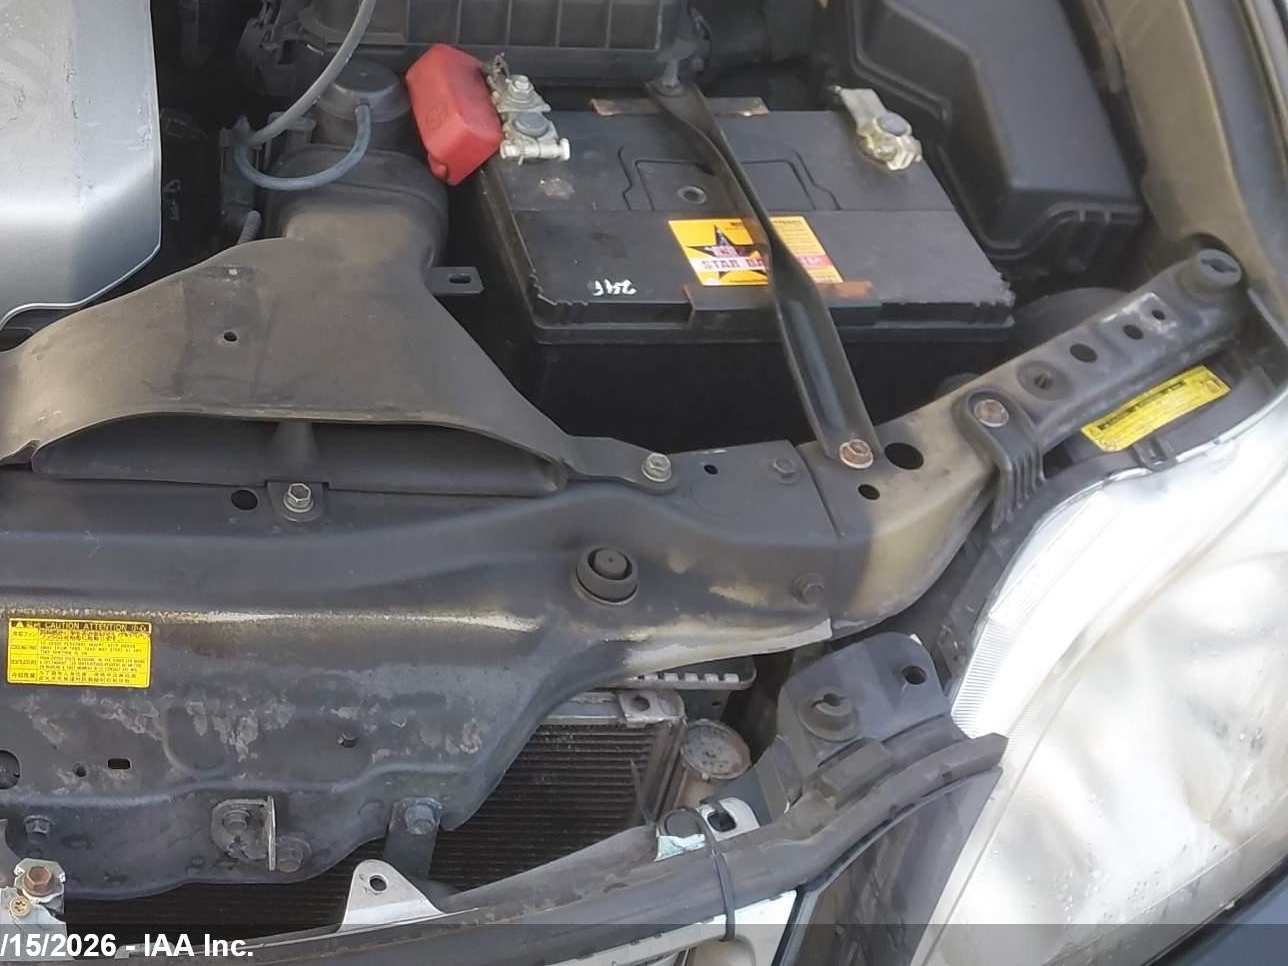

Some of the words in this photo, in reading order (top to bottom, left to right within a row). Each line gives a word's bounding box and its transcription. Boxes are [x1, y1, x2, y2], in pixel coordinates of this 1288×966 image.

[700, 259, 742, 270] STAR
[44, 622, 80, 632] CAUTION
[83, 622, 128, 633] ATTENTION
